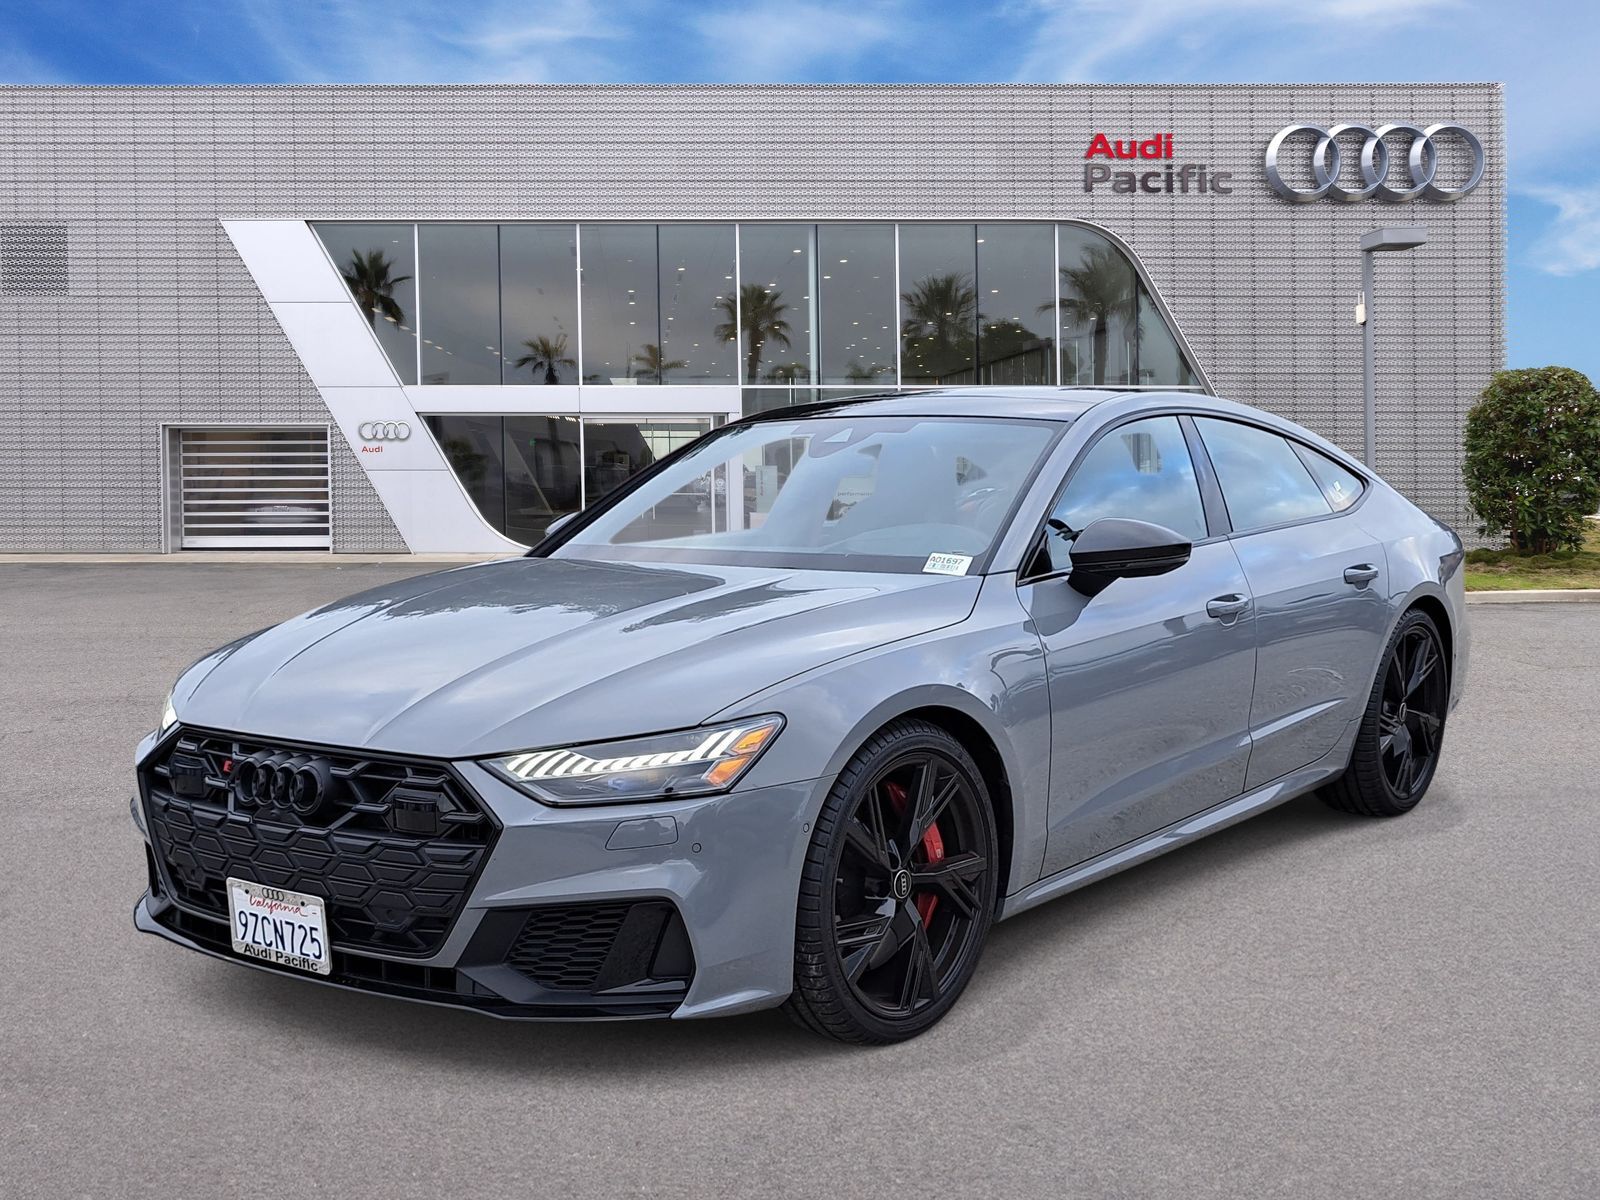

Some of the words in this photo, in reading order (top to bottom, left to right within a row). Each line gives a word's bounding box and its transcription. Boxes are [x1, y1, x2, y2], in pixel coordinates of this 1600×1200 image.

[1085, 133, 1173, 159] Audi
[1084, 163, 1233, 194] Pacific
[249, 895, 308, 917] California
[238, 910, 322, 959] 9ZCN725
[243, 943, 272, 959] Audi
[275, 951, 319, 972] Pacific
